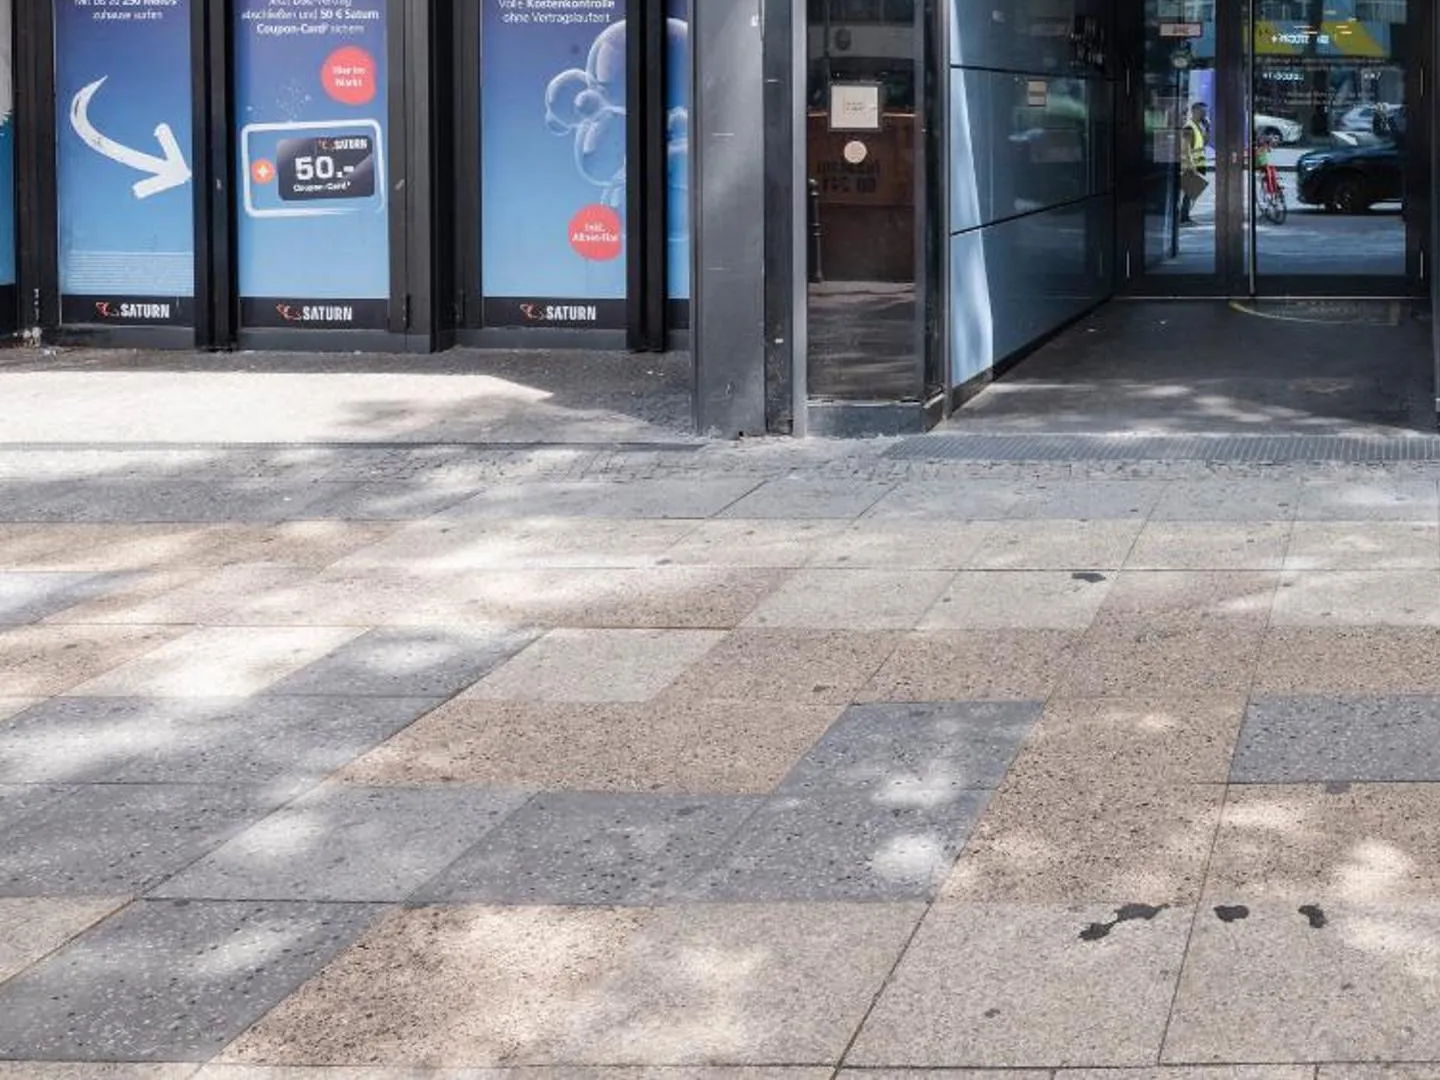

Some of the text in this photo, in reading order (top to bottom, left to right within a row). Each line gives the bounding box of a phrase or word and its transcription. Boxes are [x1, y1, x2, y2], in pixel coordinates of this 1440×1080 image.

[120, 303, 170, 319] SATURN
[302, 306, 352, 321] SATURN
[546, 306, 597, 320] SATURN
